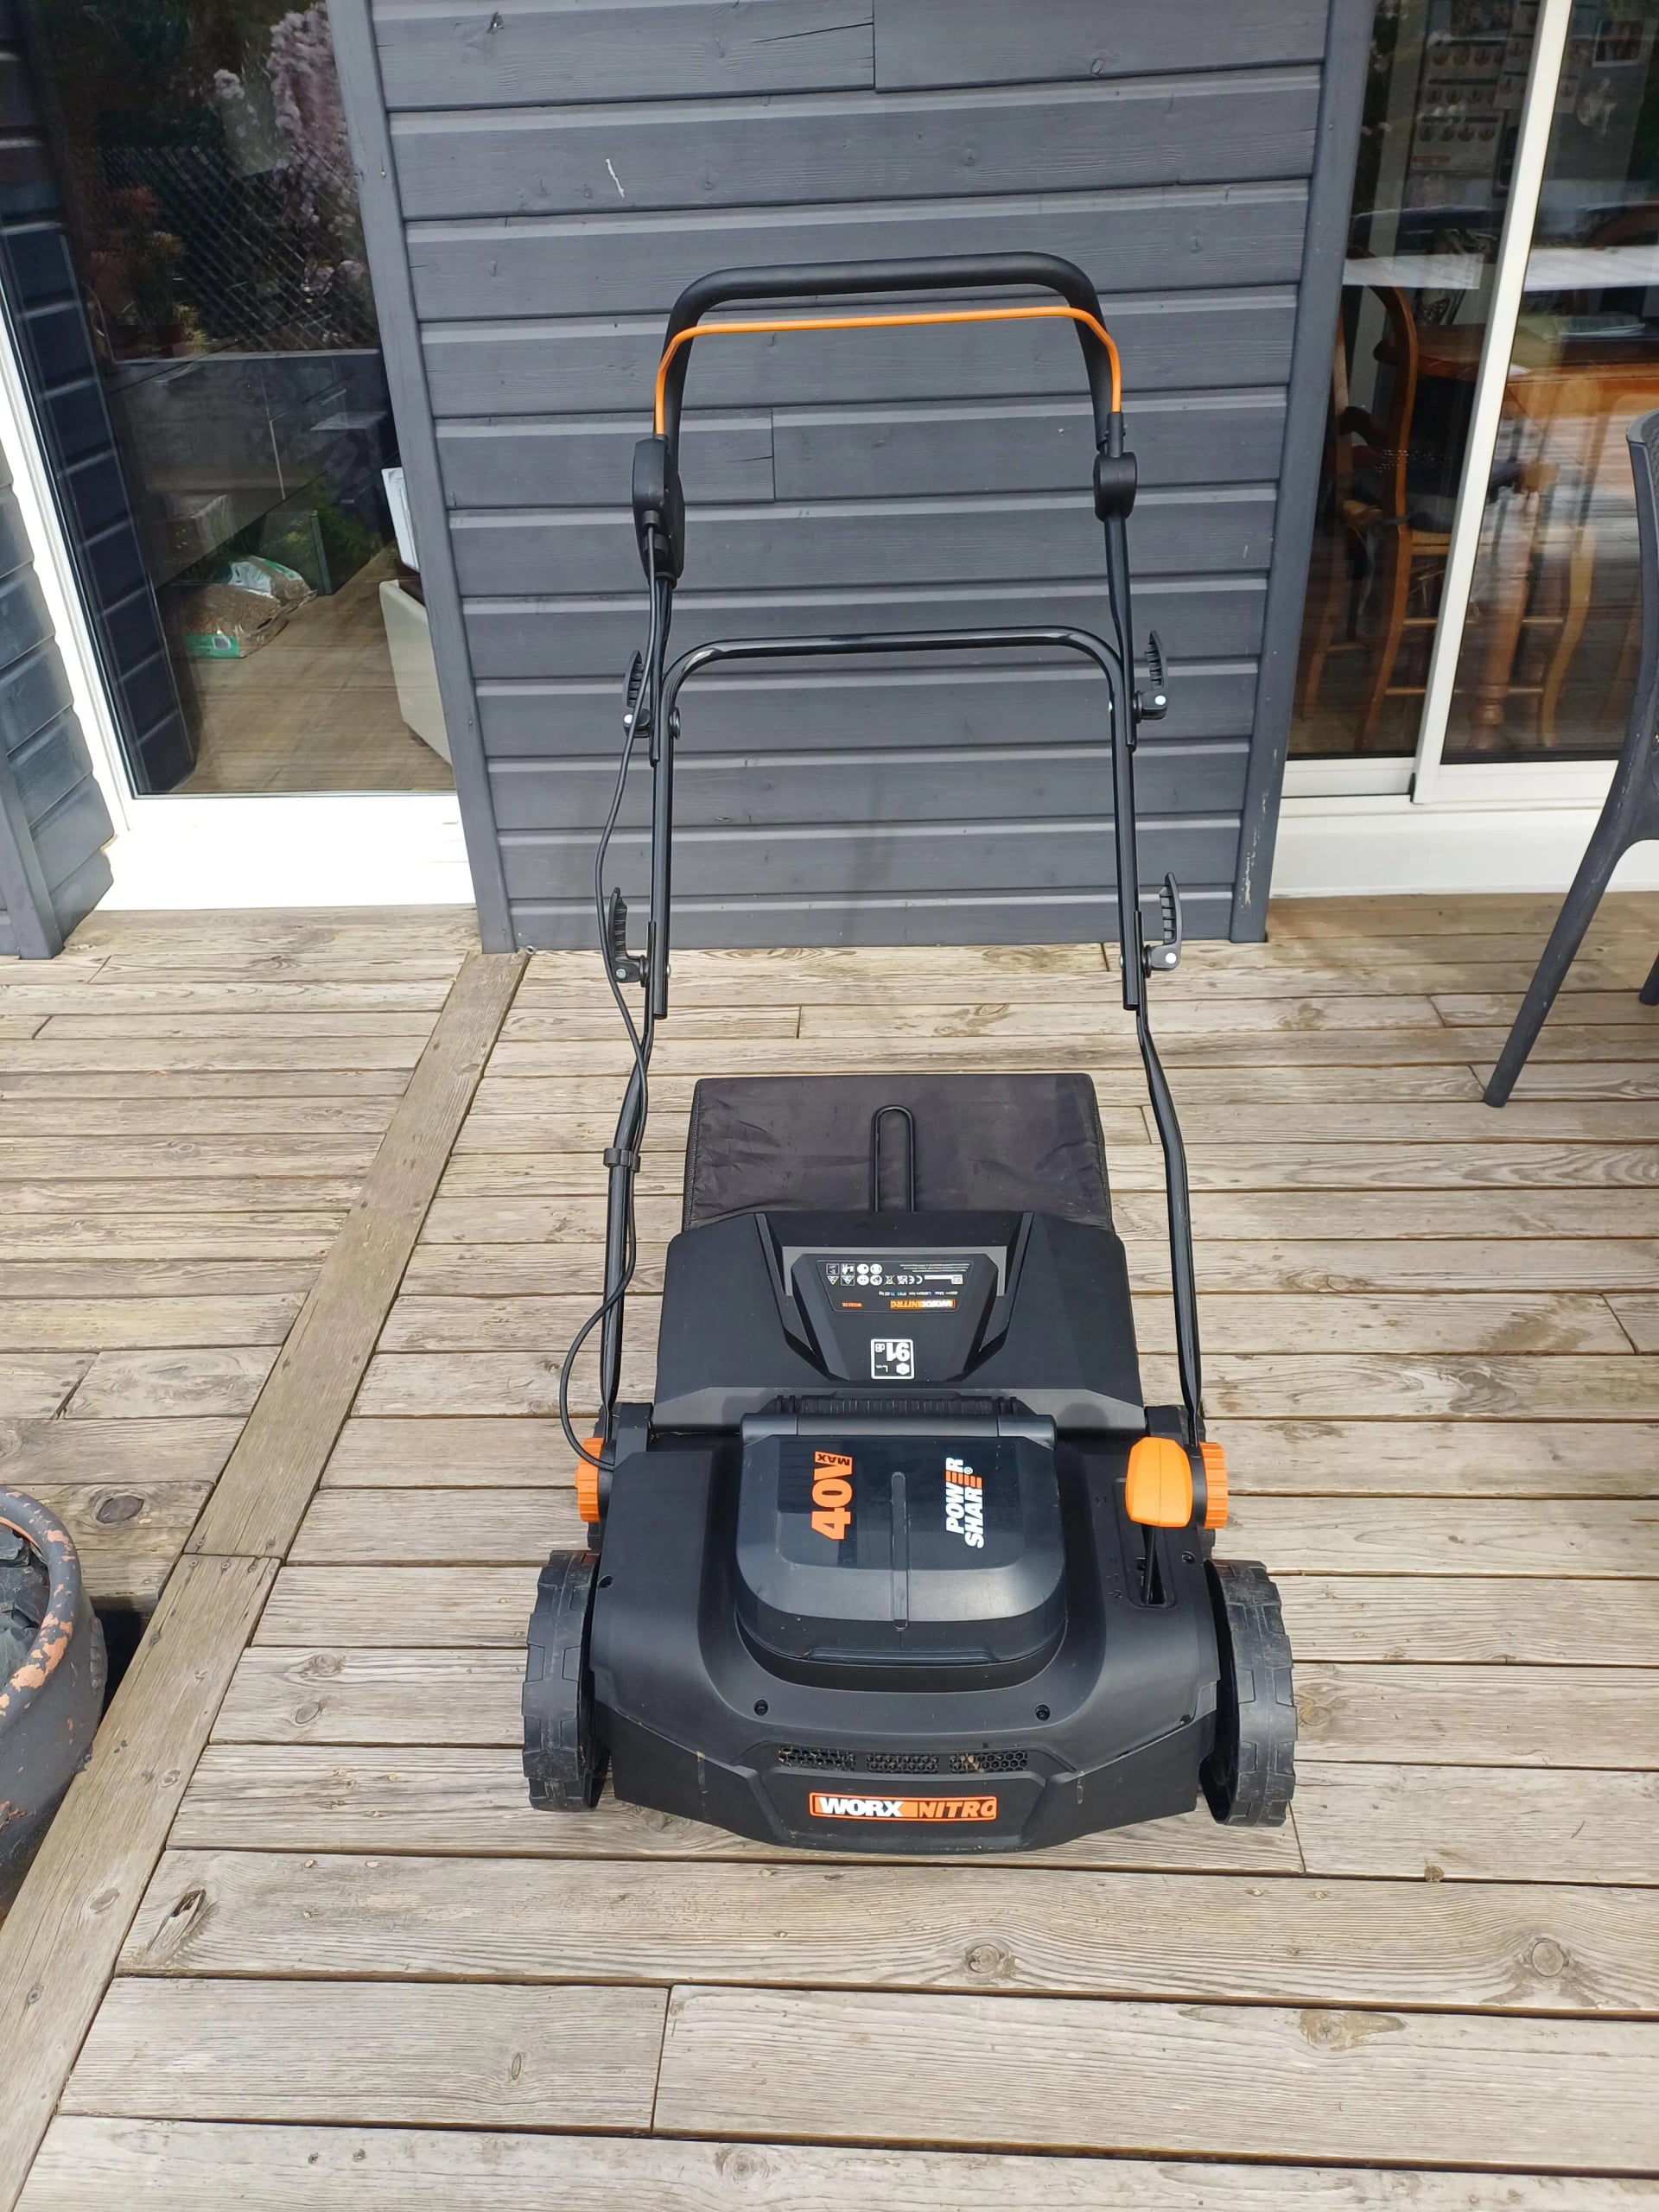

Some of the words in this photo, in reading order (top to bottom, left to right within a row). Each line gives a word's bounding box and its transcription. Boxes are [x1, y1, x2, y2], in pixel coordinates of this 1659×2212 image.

[887, 1342, 910, 1362] 91
[817, 1453, 850, 1466] MAX
[811, 1465, 853, 1540] 40V
[946, 1458, 964, 1535] POWER
[964, 1474, 984, 1548] SHARE
[818, 1796, 903, 1818] WORX
[918, 1800, 995, 1818] NITRO
